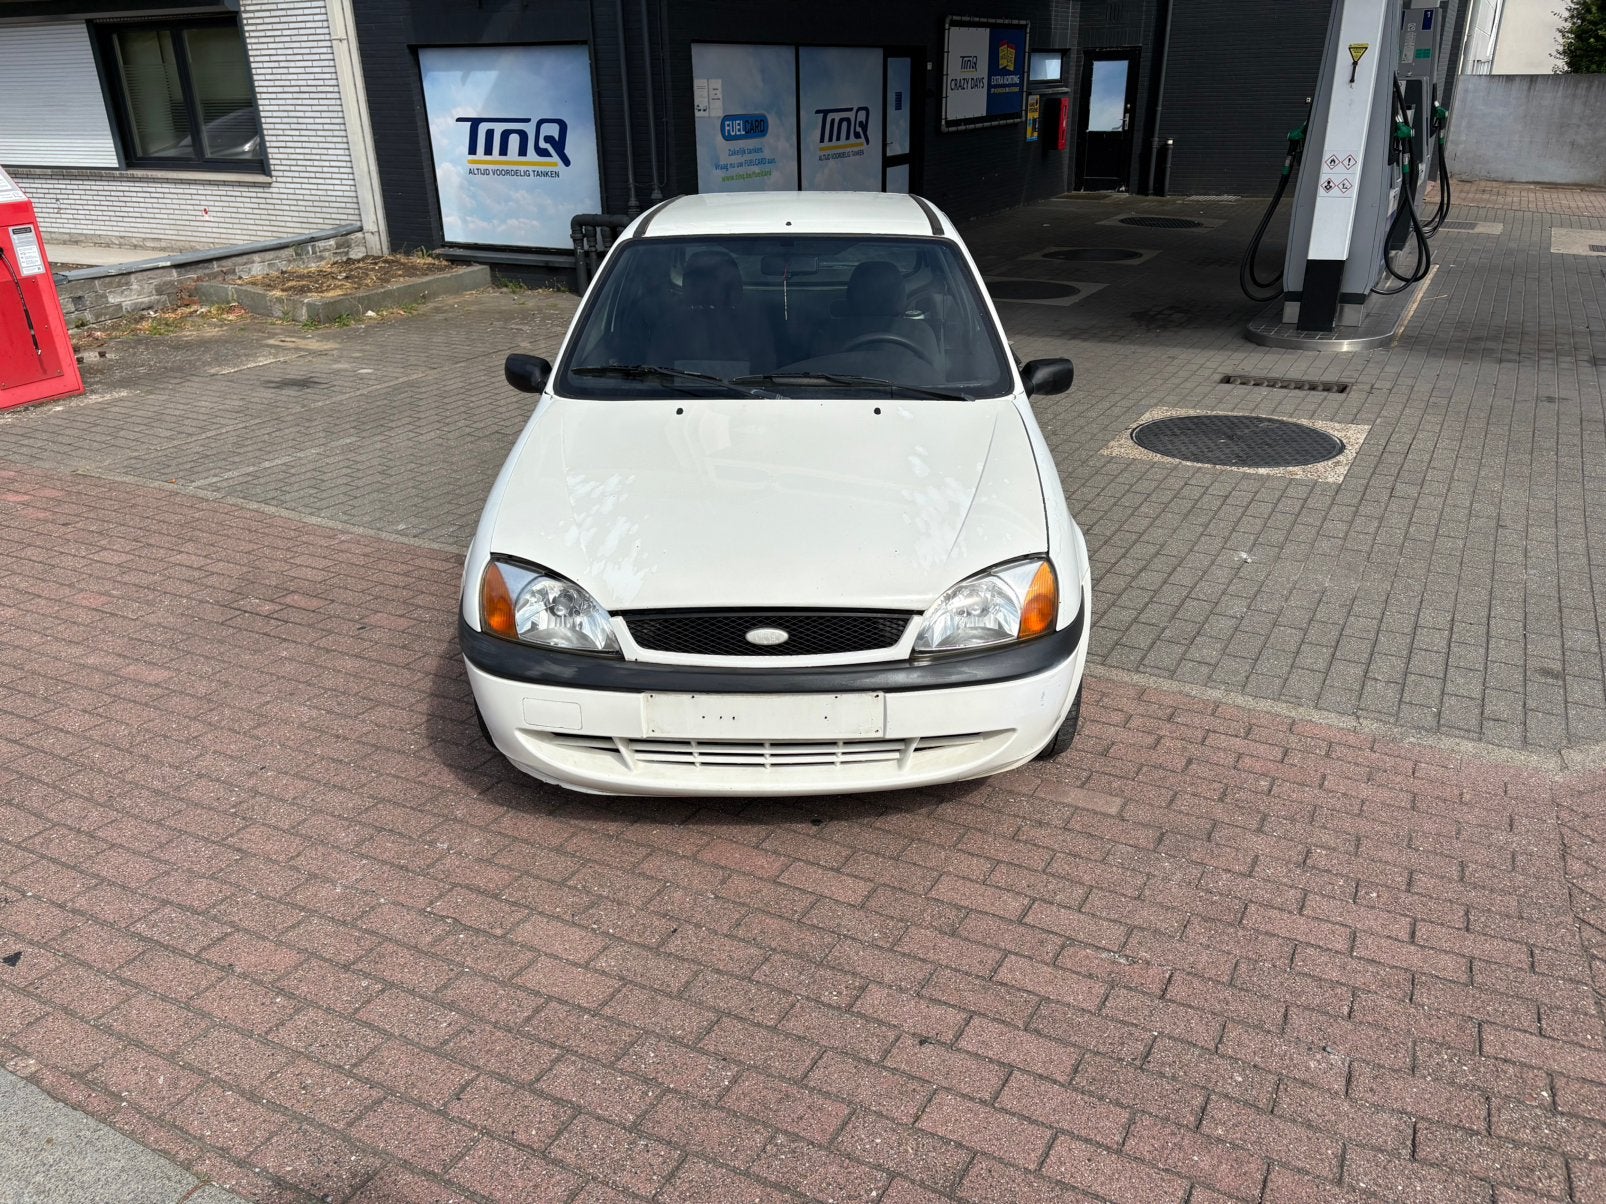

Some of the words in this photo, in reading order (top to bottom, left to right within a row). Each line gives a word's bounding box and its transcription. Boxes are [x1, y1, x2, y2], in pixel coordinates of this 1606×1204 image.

[950, 78, 970, 91] CRAZY
[971, 77, 985, 90] DAYS
[725, 119, 765, 136] FUELCARD
[815, 106, 870, 146] TinQ
[455, 117, 571, 167] TinQ
[728, 148, 746, 157] Zakelijk
[468, 168, 490, 176] ALTIJD
[491, 169, 531, 177] VOORDELIG
[532, 169, 560, 178] TANKEN
[714, 162, 729, 172] Vraag
